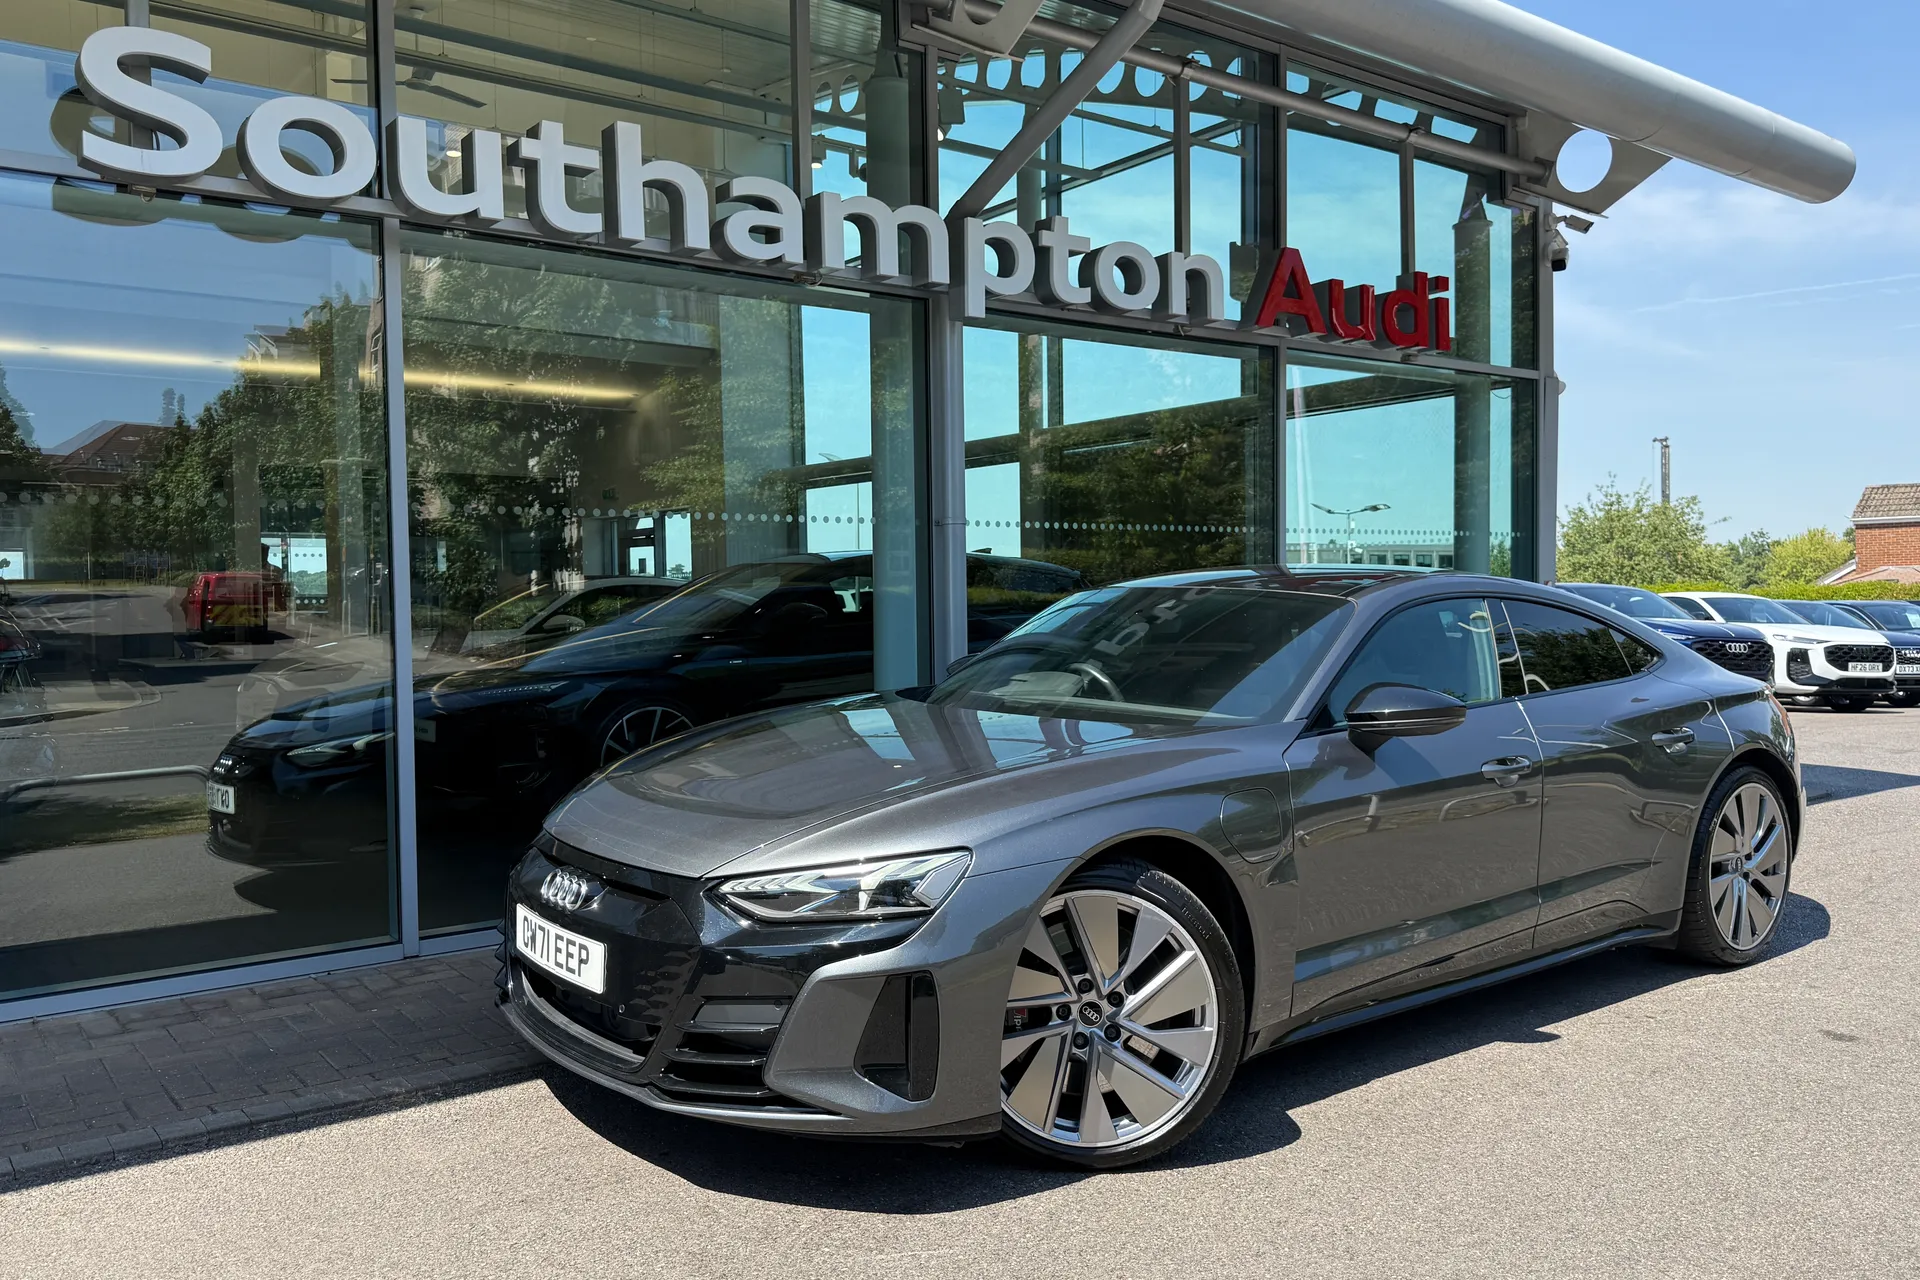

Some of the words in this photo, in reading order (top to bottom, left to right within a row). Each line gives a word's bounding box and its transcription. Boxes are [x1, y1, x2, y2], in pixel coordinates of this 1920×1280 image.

[77, 26, 1225, 321] Southampton
[1255, 246, 1451, 351] Audi
[522, 915, 550, 963] CW71
[554, 932, 590, 978] EEP
